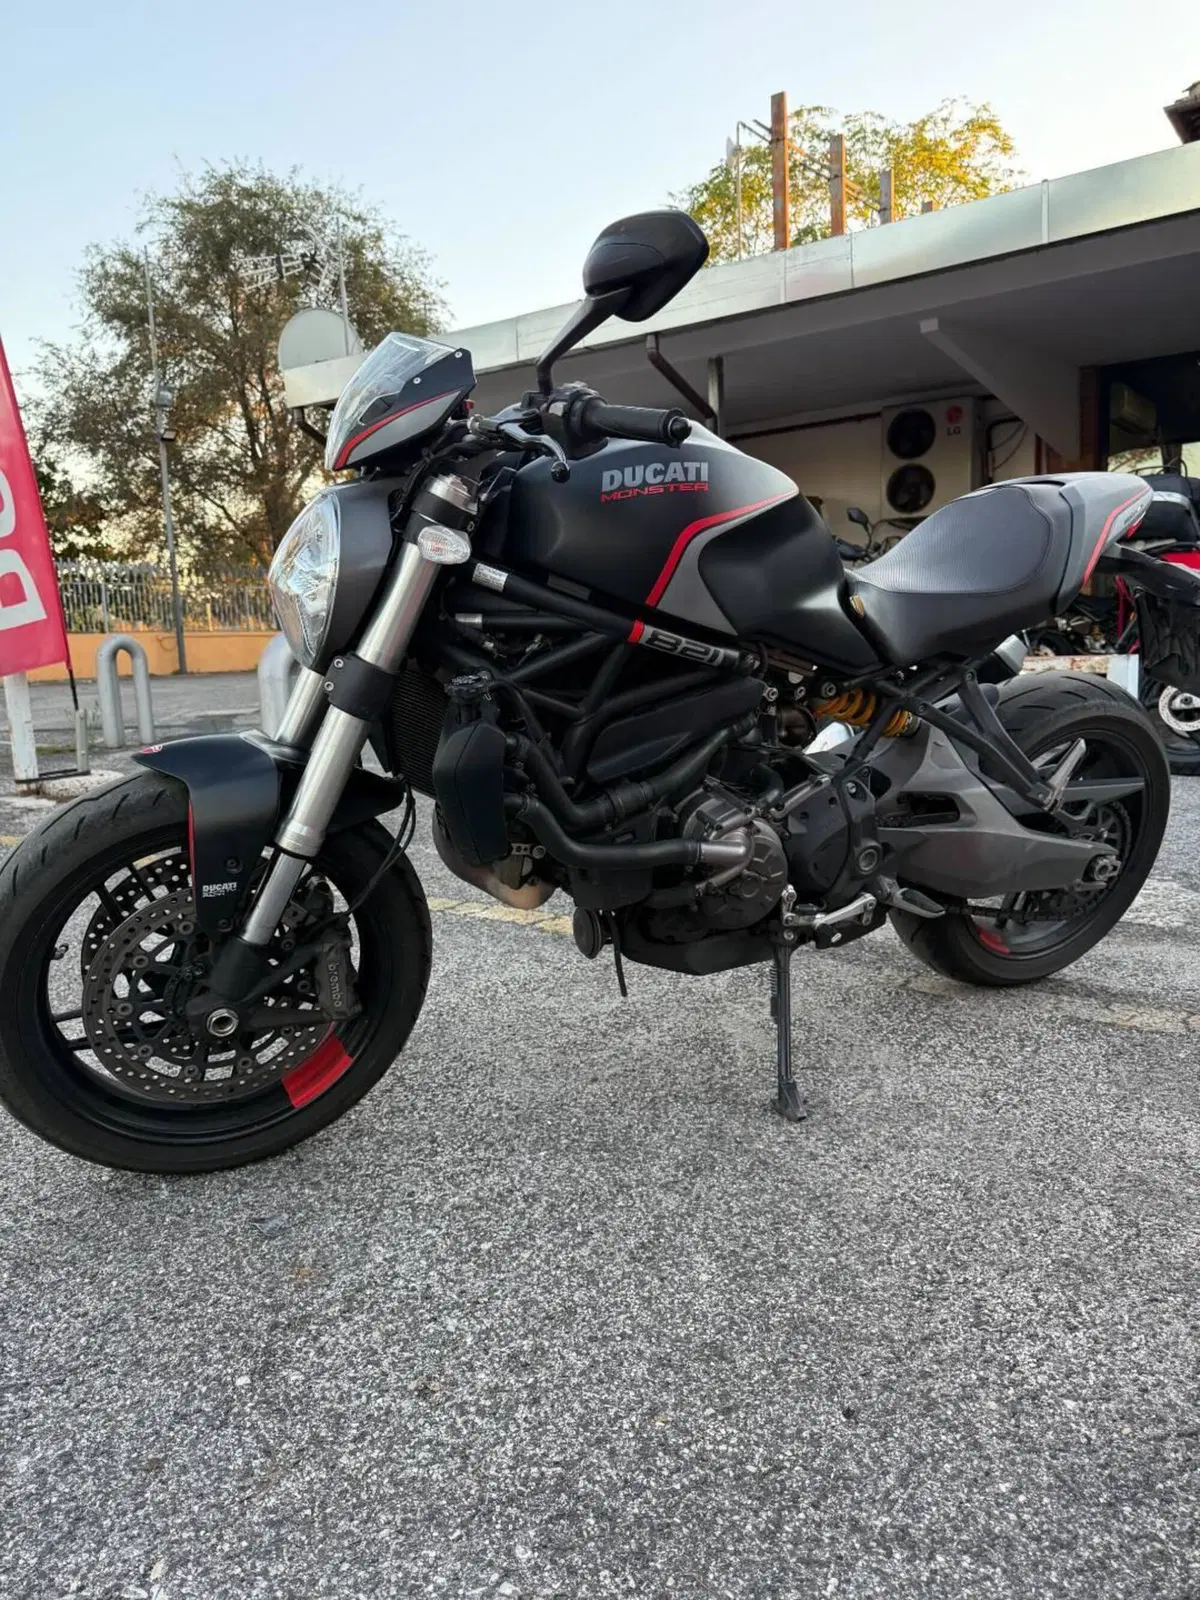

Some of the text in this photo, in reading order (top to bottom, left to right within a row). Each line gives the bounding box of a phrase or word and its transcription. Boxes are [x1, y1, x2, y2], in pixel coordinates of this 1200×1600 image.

[946, 426, 961, 436] LG
[602, 462, 709, 492] DUCATI
[601, 482, 709, 503] MONSTER
[645, 629, 721, 664] 821
[202, 882, 237, 892] DUCATI
[328, 961, 344, 1008] brembo
